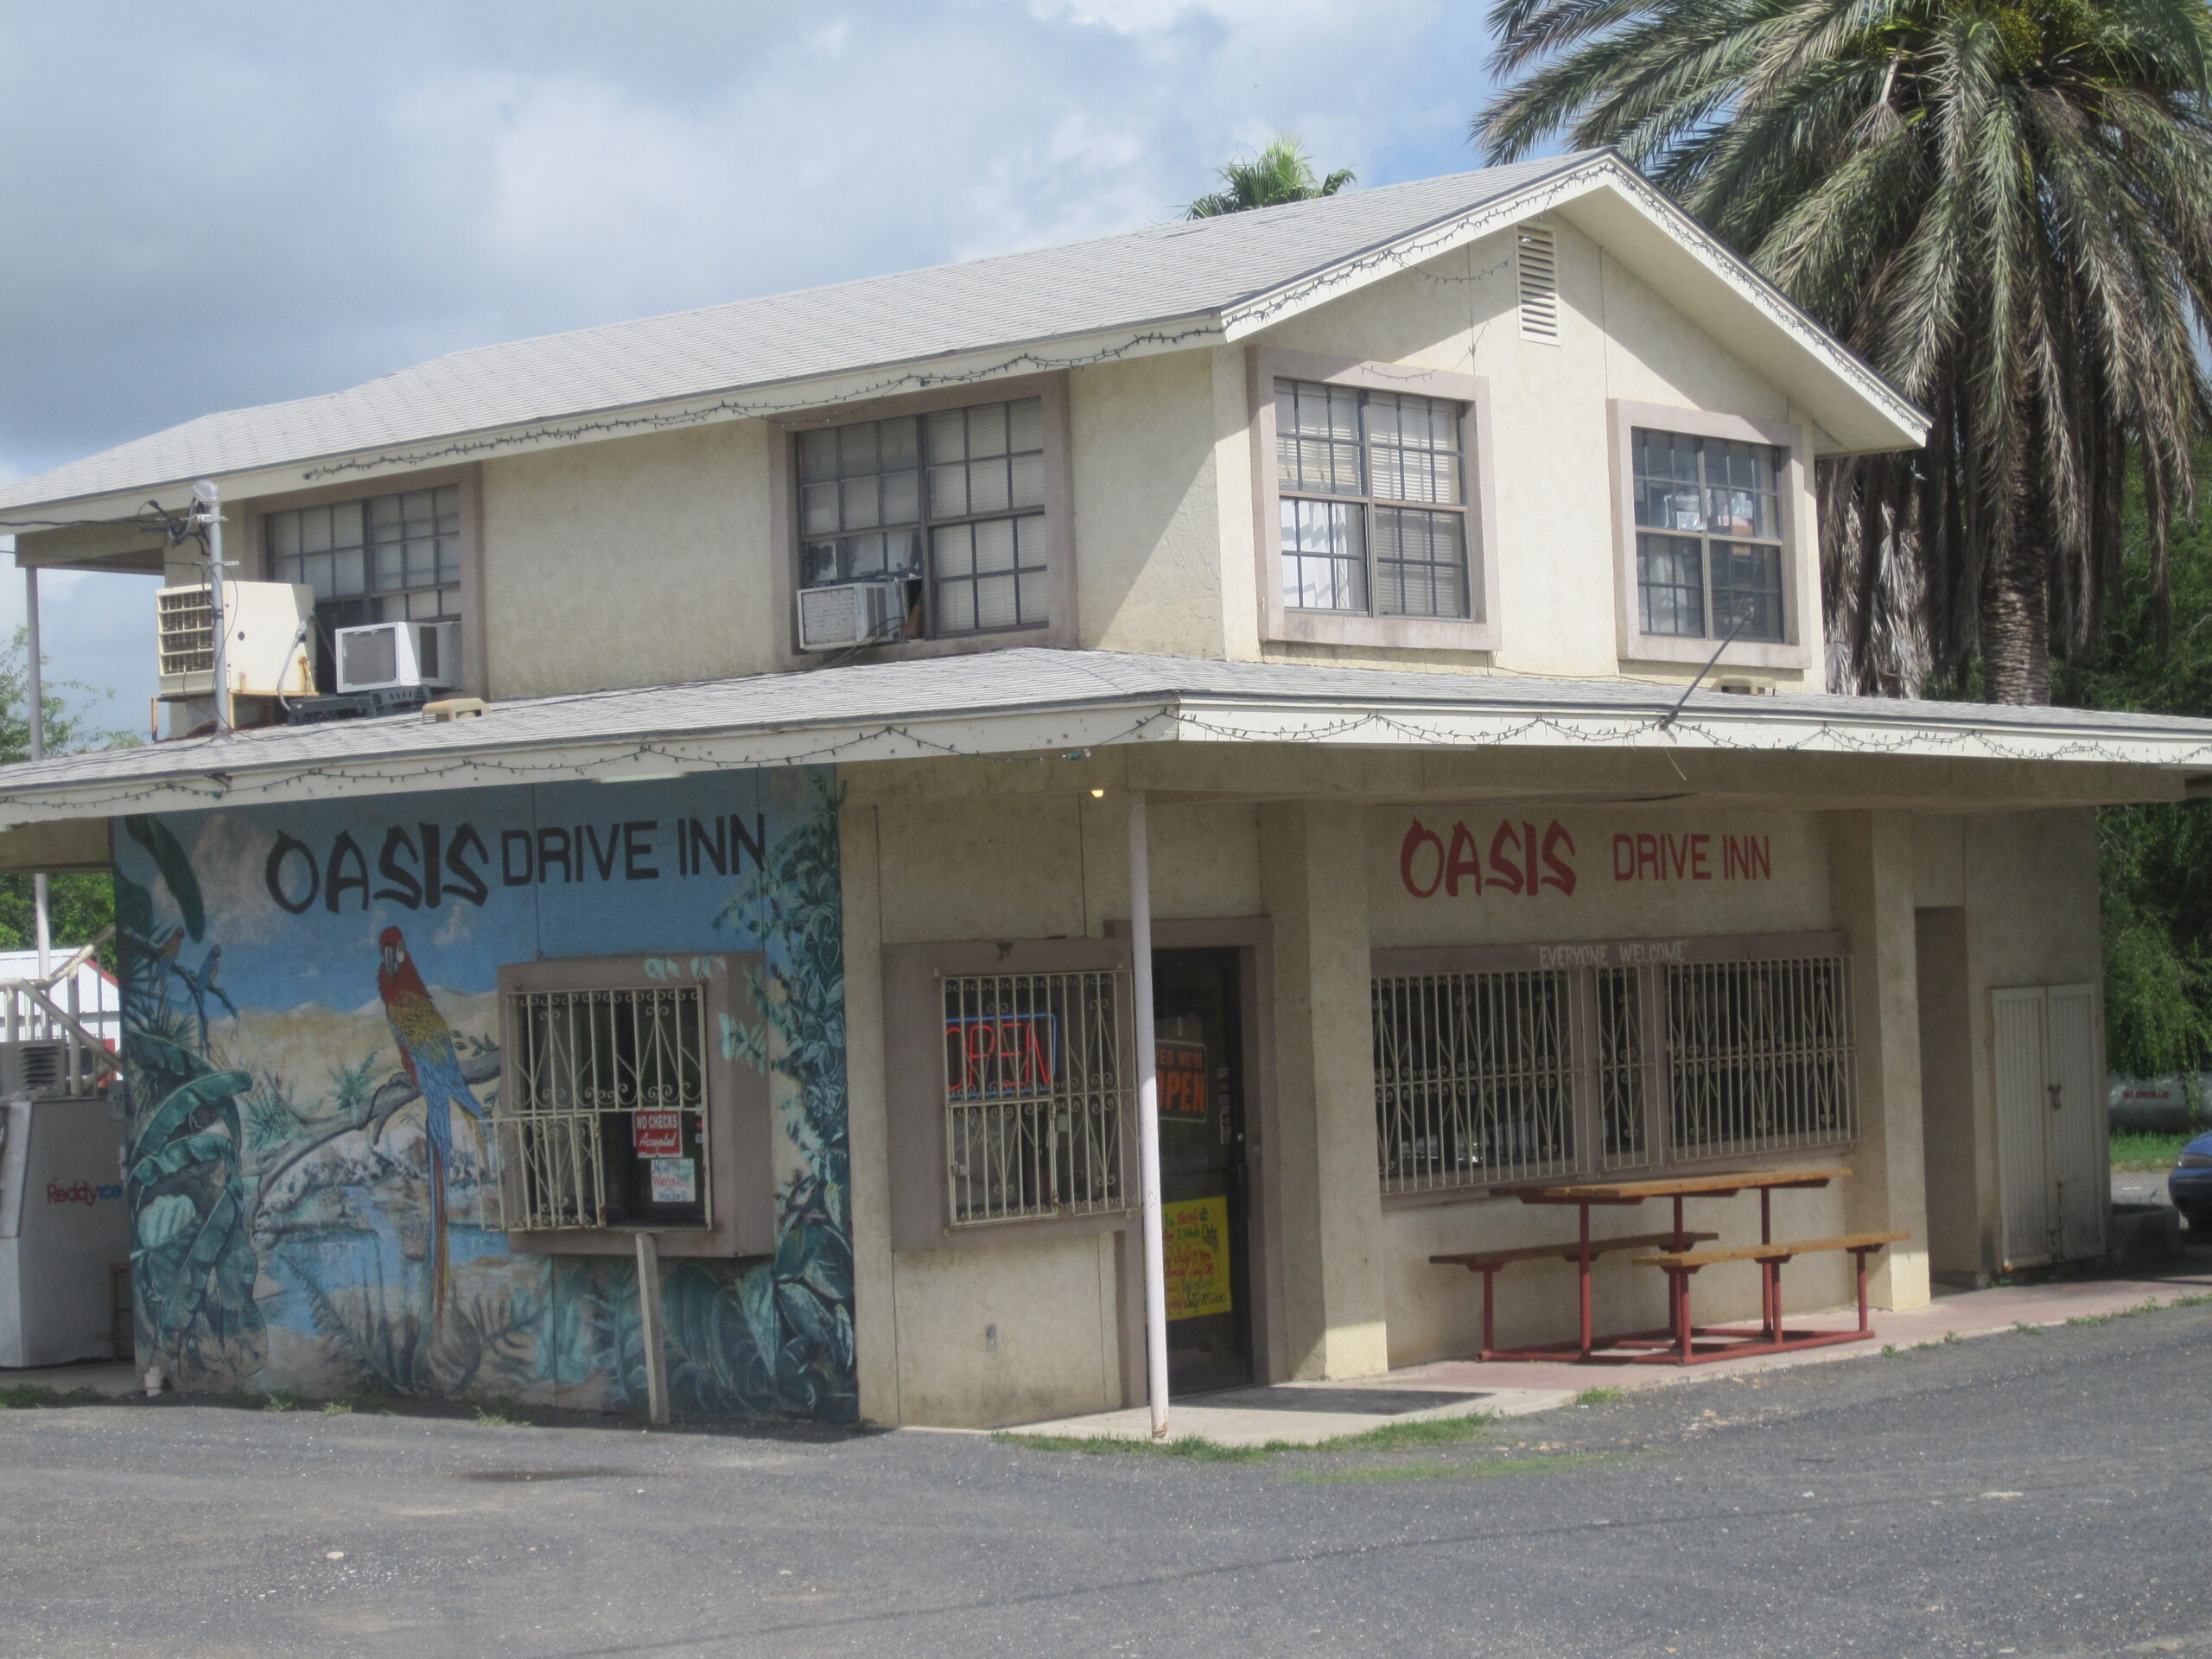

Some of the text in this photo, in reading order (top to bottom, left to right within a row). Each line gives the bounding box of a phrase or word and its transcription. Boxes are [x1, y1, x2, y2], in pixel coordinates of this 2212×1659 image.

[265, 813, 766, 914] OASIS DRIVE INN
[1400, 817, 1770, 898] OASIS DRIVE INN
[947, 1023, 1051, 1090] OPEN
[637, 1114, 677, 1129] NO CHECKS
[639, 1132, 676, 1151] Accepted
